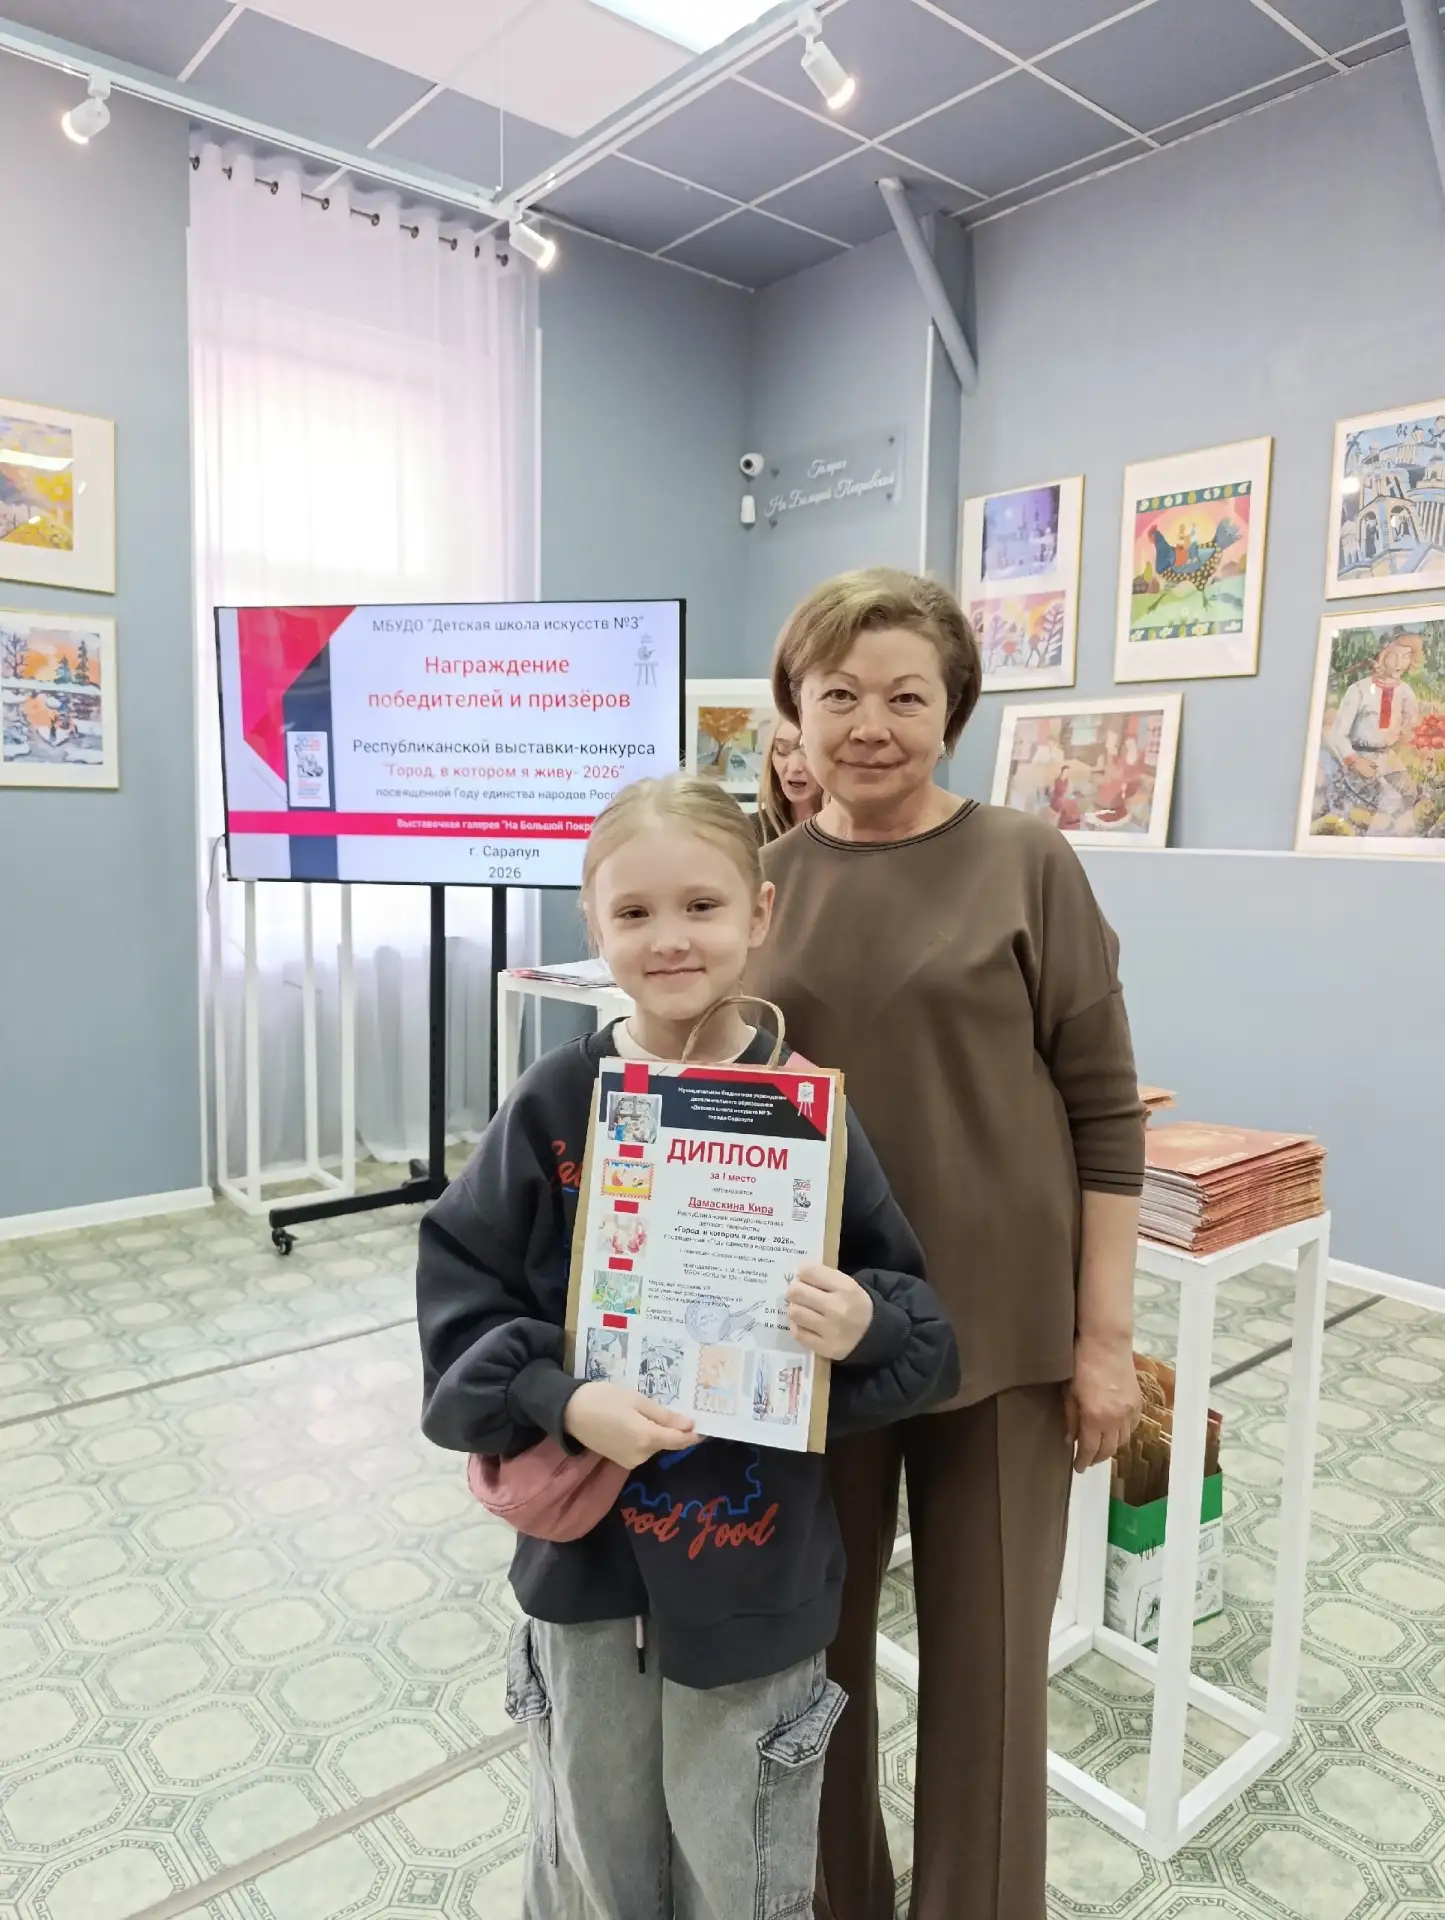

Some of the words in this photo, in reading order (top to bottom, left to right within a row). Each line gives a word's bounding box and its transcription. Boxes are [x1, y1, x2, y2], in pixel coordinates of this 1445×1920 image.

[372, 619, 423, 633] МБУДО
[427, 618, 491, 633] "Детская
[494, 619, 540, 631] школа
[544, 618, 609, 632] искусств
[425, 656, 569, 677] Награждение
[368, 688, 503, 711] победителей
[510, 693, 521, 708] и
[529, 688, 630, 712] призёров
[353, 738, 490, 757] Республиканской
[495, 742, 655, 758] выставки-конкурса
[440, 767, 449, 777] в
[454, 766, 516, 781] котором
[521, 767, 529, 778] я
[583, 764, 625, 779] 2026"
[376, 787, 450, 799] посвященной
[454, 786, 479, 800] Году
[483, 789, 535, 800] единства
[538, 788, 586, 800] народов
[590, 788, 615, 800] Росс
[397, 818, 460, 829] Выставочная
[462, 819, 500, 831] галерея
[501, 820, 518, 830] "На
[520, 820, 563, 831] Большой
[469, 846, 479, 857] г.
[483, 844, 540, 860] Сарапул
[488, 866, 521, 880] 2026
[666, 1138, 788, 1170] ДИПЛОМ
[709, 1172, 720, 1180] за
[728, 1174, 757, 1184] место
[688, 1196, 745, 1212] Дамаскина
[748, 1202, 774, 1215] Кира
[709, 1230, 740, 1241] котором
[748, 1234, 766, 1243] живу
